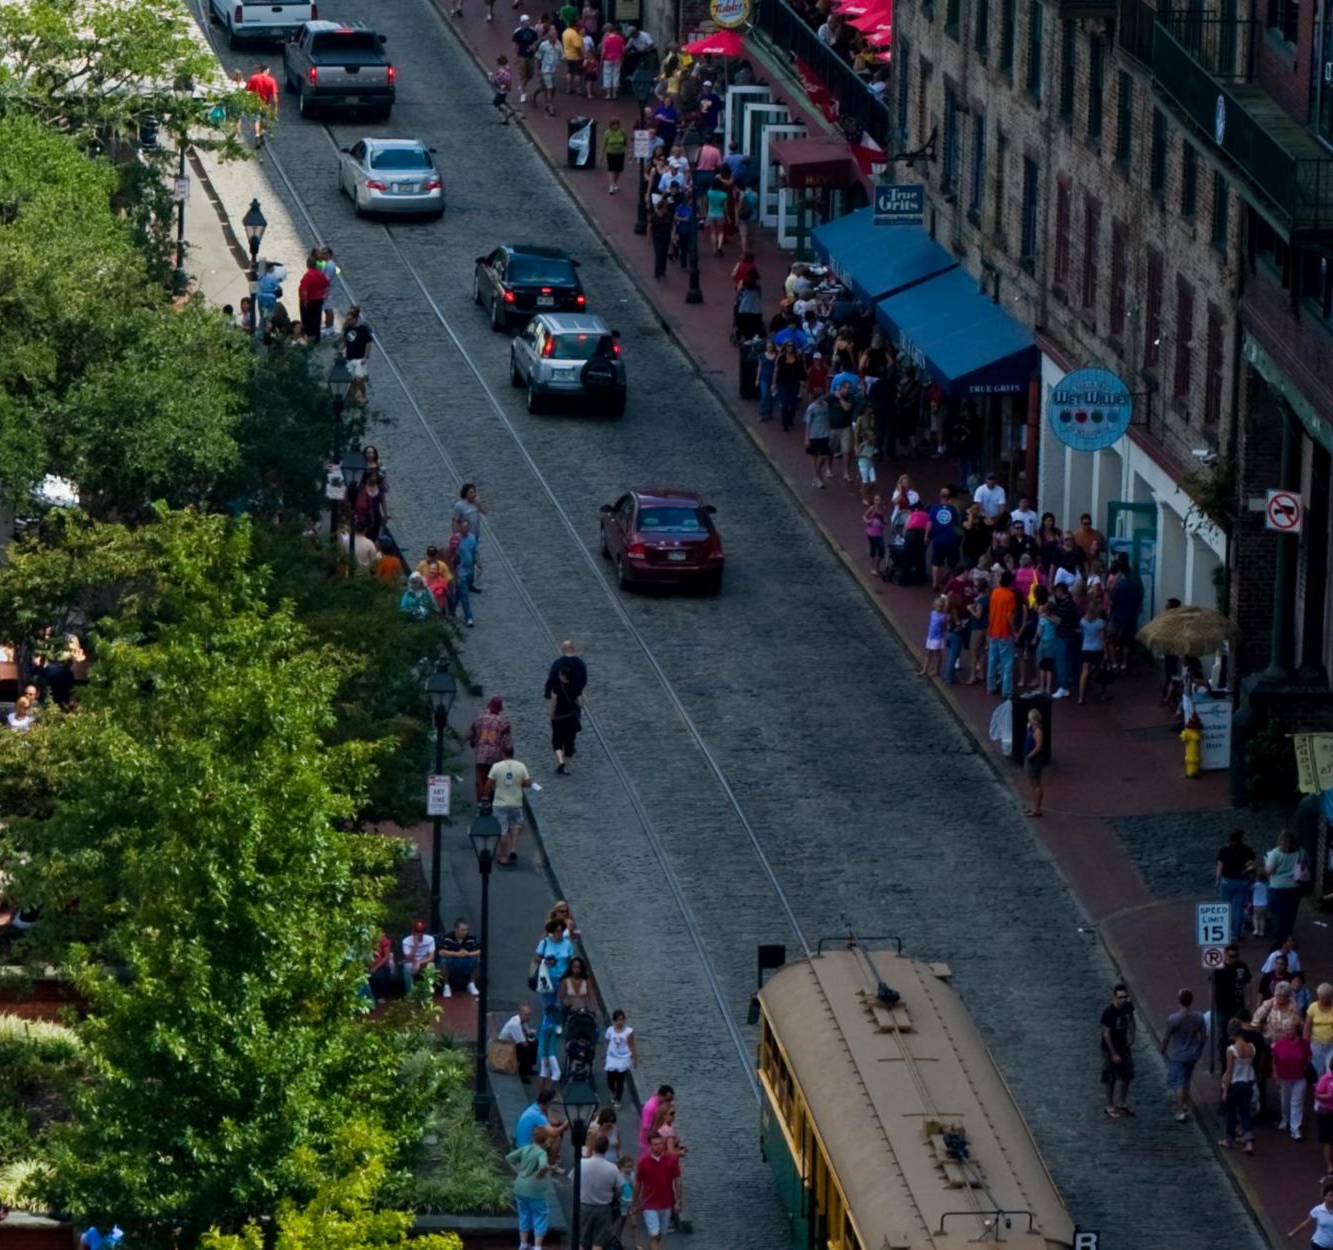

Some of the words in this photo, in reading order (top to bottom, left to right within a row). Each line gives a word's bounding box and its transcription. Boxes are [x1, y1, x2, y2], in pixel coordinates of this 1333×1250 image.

[887, 187, 918, 201] True
[878, 195, 919, 212] Grits
[1200, 906, 1228, 914] SPEED
[1202, 916, 1224, 924] LIMIT
[1203, 925, 1224, 941] 15
